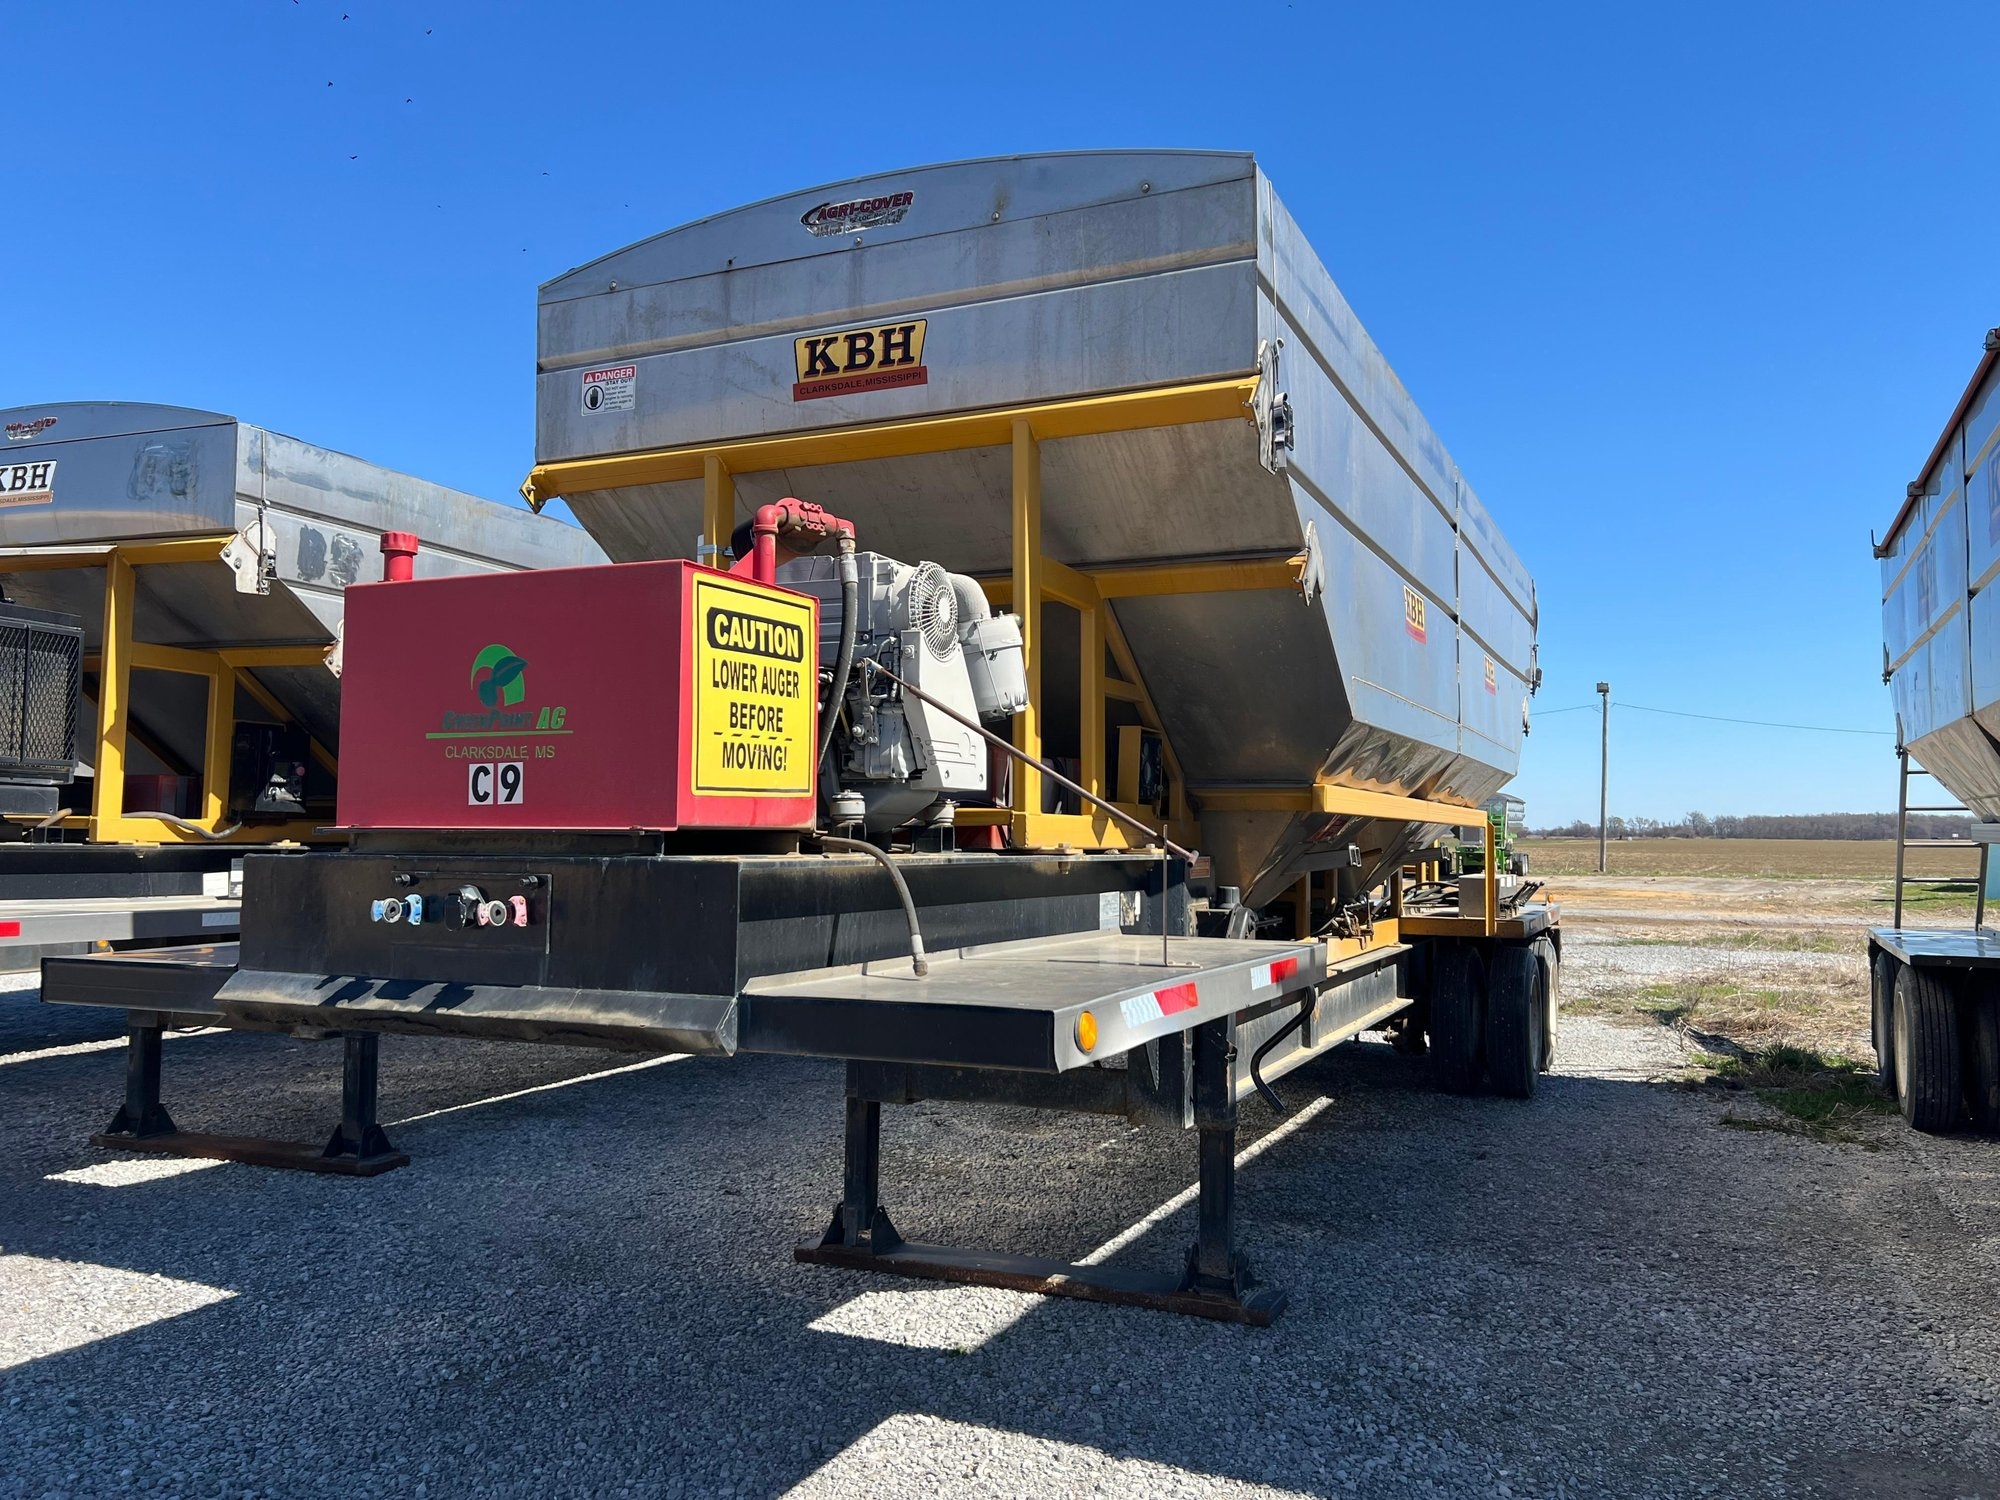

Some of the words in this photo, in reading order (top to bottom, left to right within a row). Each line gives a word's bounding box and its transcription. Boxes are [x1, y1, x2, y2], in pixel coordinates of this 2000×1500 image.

[817, 192, 914, 221] AGRI-COVER
[804, 325, 916, 378] KBH
[595, 369, 632, 381] DANGER
[1406, 588, 1424, 628] KBH
[714, 613, 799, 658] CAUTION
[712, 658, 758, 693] LOWER
[761, 666, 800, 699] AUGER
[536, 707, 567, 729] AG
[730, 702, 783, 733] BEFORE
[535, 746, 555, 758] MS
[722, 742, 787, 771] MOVING!
